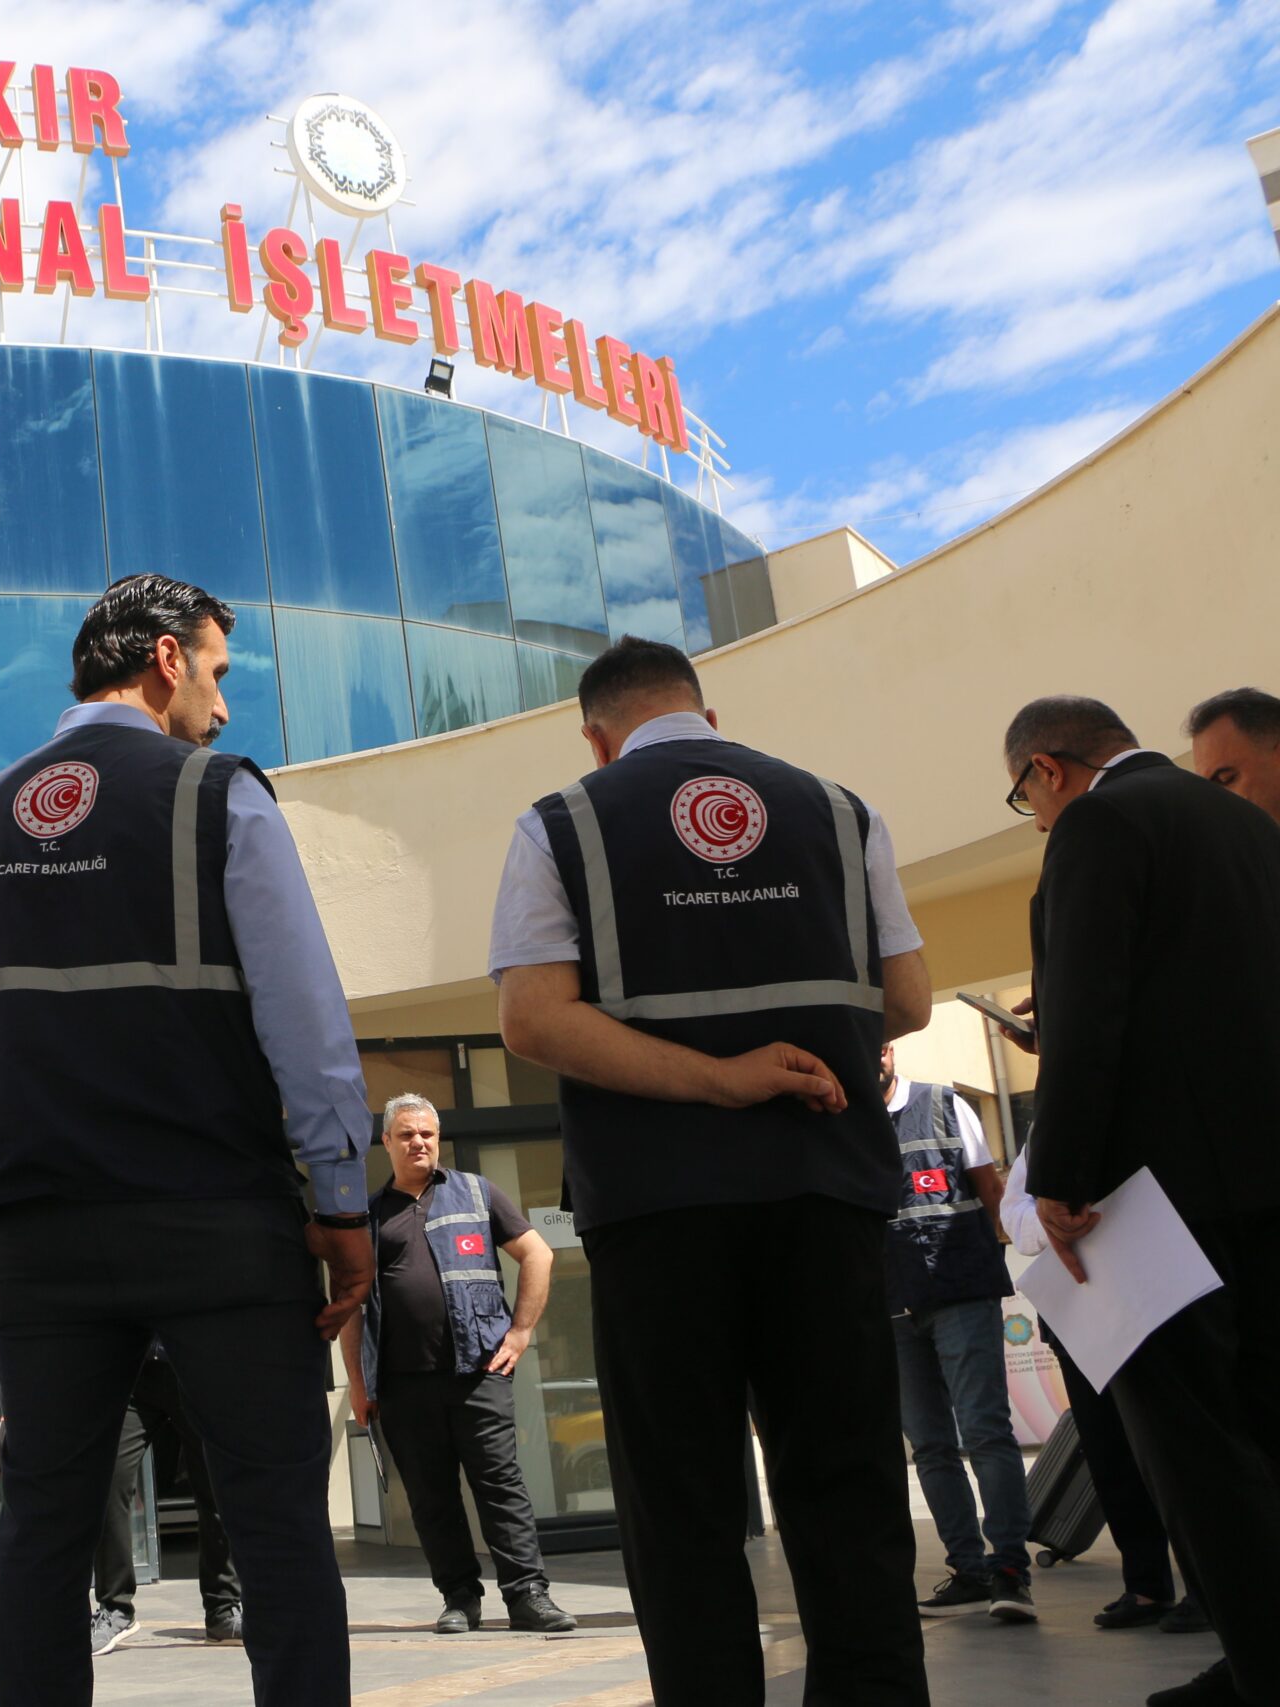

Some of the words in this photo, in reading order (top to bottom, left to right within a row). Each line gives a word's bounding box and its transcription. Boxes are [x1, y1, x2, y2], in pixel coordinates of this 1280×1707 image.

[220, 203, 689, 453] İŞLETMELERİ
[39, 840, 60, 853] T.C.
[41, 854, 107, 876] BAKANLIĞI
[713, 867, 740, 880] T.C.
[663, 890, 720, 906] TİCARET
[721, 882, 800, 904] BAKANLIĞI
